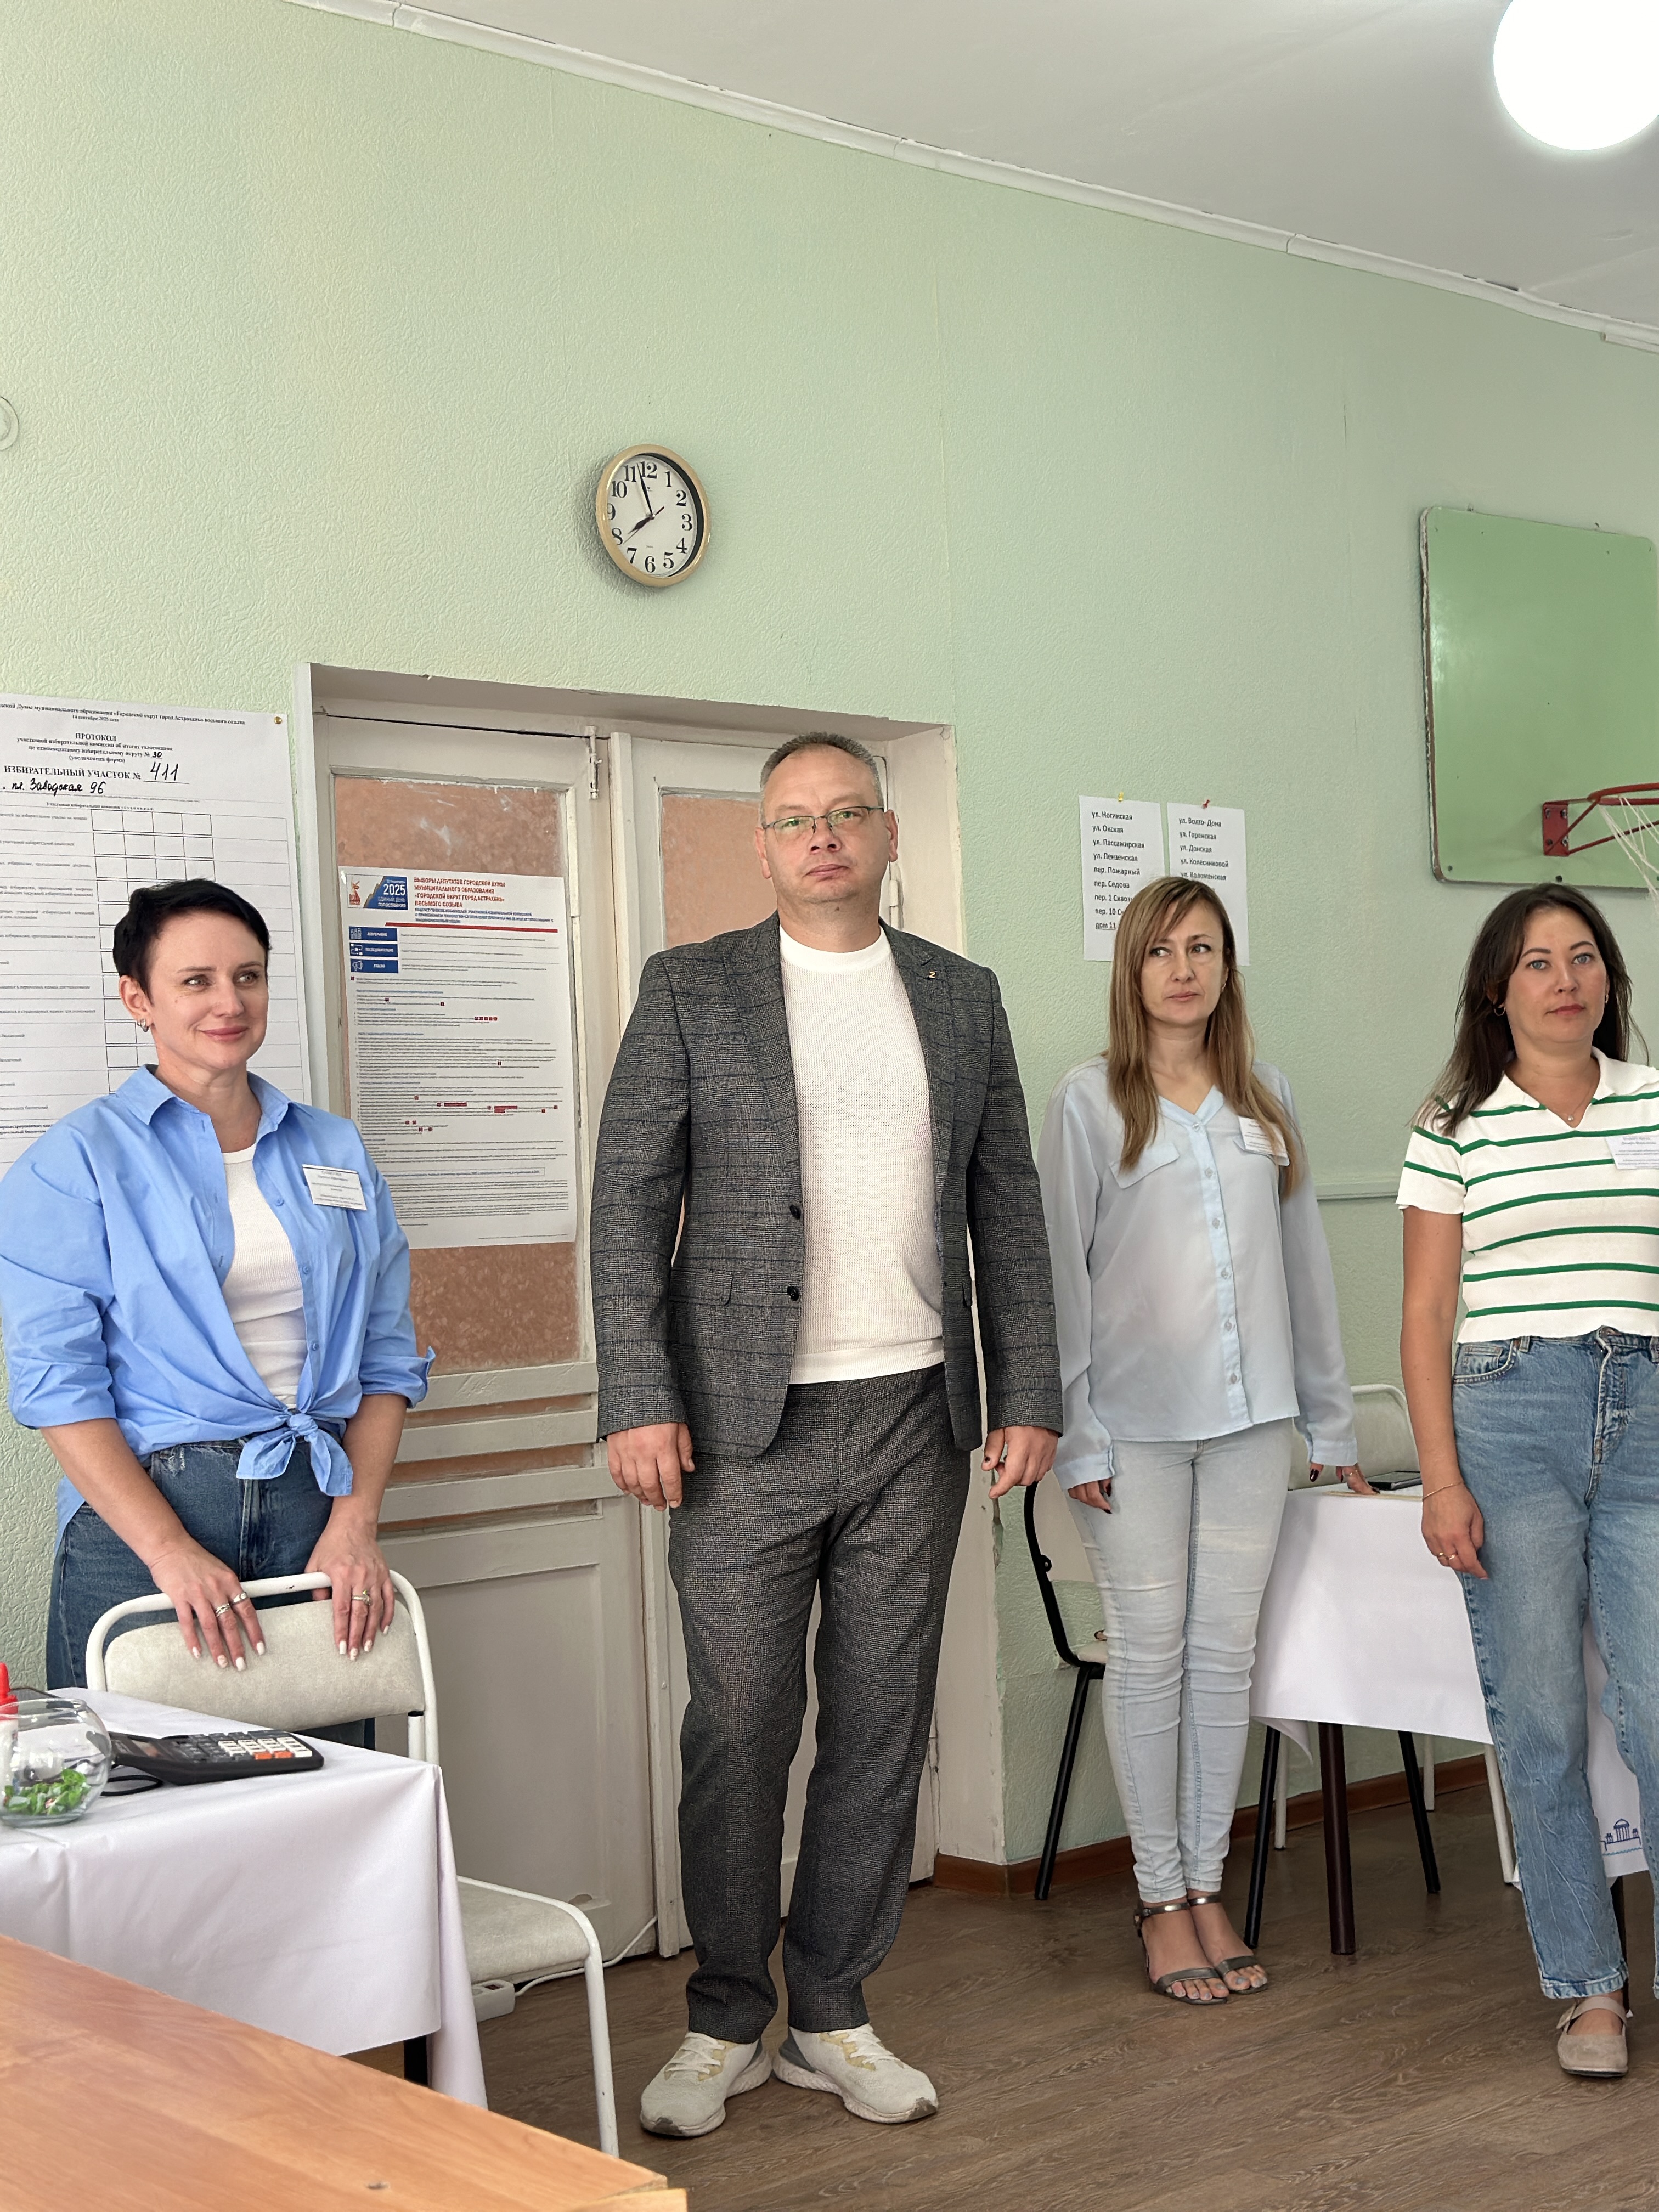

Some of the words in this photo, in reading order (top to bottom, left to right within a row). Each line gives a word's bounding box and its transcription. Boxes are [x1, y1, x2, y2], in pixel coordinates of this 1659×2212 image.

[623, 465, 637, 483] 11
[638, 461, 658, 479] 12
[664, 471, 672, 488] 1
[611, 480, 628, 498] 10
[676, 489, 687, 507] 2
[607, 503, 616, 520] 9
[681, 514, 692, 531] 3
[612, 527, 623, 545] 8
[676, 537, 687, 554] 4
[627, 547, 637, 564] 7
[663, 552, 674, 569] 5
[644, 556, 656, 573] 6
[76, 732, 116, 741] ПРОТОКОЛ
[4, 765, 85, 777] ИЗБИРАТЕЛЬНЫЙ
[88, 770, 131, 779] УЧАСТОК
[150, 761, 179, 781] 411
[90, 781, 106, 794] 96
[1102, 811, 1132, 820] Ногинская
[1207, 819, 1222, 827] Дона
[1102, 825, 1124, 833] Окская
[1188, 831, 1217, 840] Горенская
[1103, 838, 1145, 849] Пассажирская
[1189, 844, 1212, 853] Донская
[1103, 853, 1138, 862] Пензенская
[1189, 857, 1229, 867] Колесниковой
[1108, 866, 1141, 876] Пожарный
[383, 884, 405, 896] 2025
[1108, 880, 1130, 889] Седова
